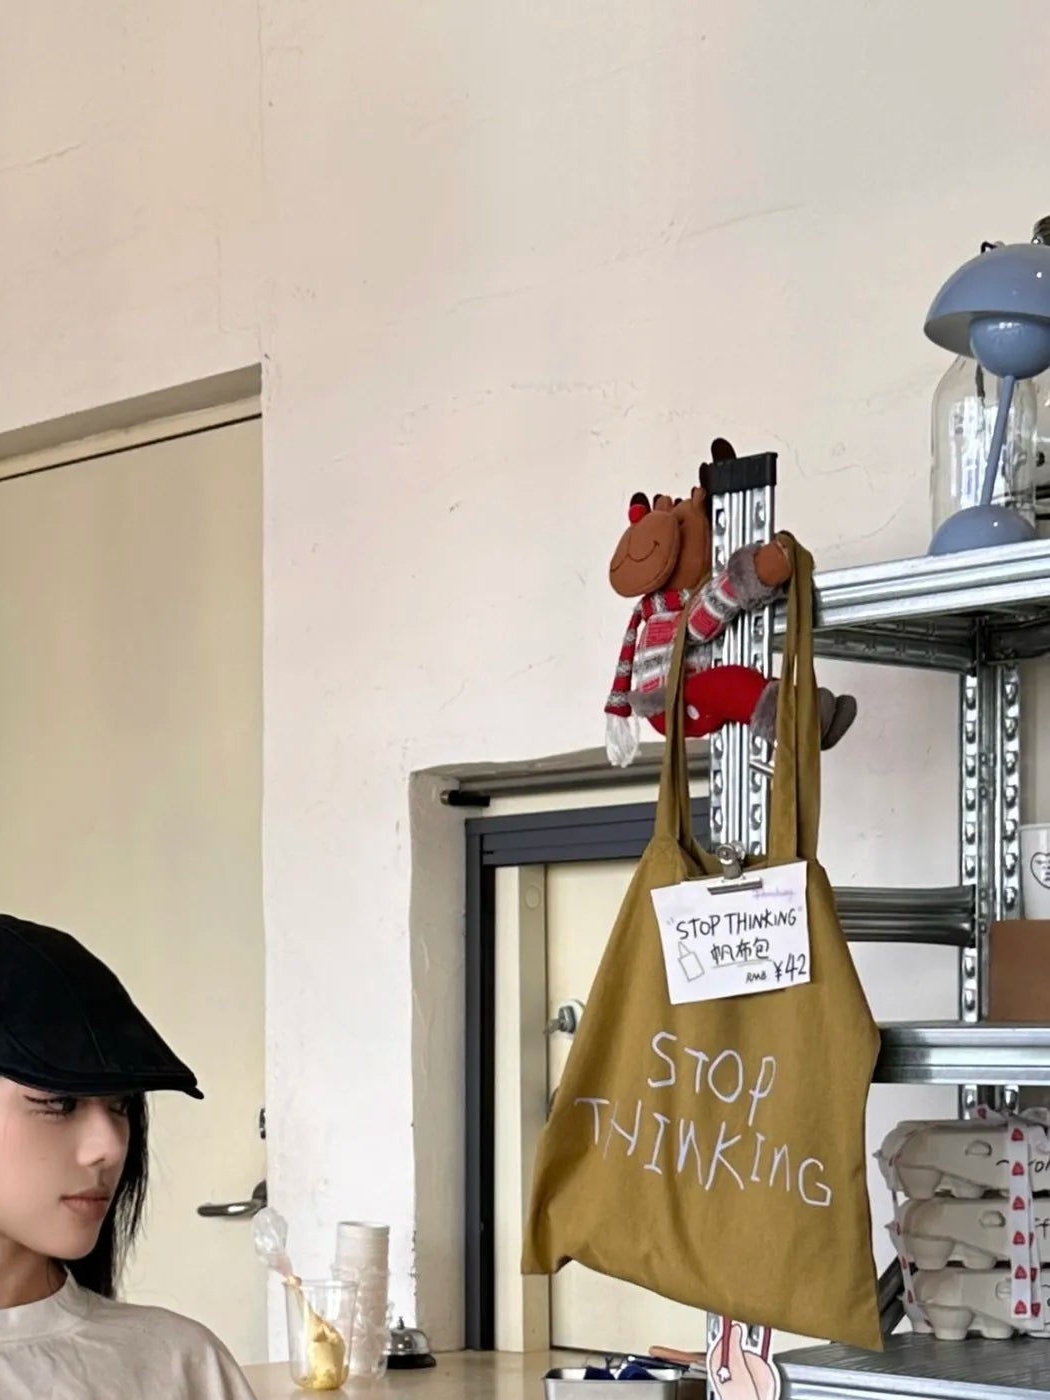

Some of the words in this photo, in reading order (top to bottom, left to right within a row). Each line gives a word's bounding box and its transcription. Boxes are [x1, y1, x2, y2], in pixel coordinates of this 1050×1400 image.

[710, 937, 770, 966] 帆布包
[773, 953, 807, 983] ¥42
[646, 1030, 777, 1127] STOP
